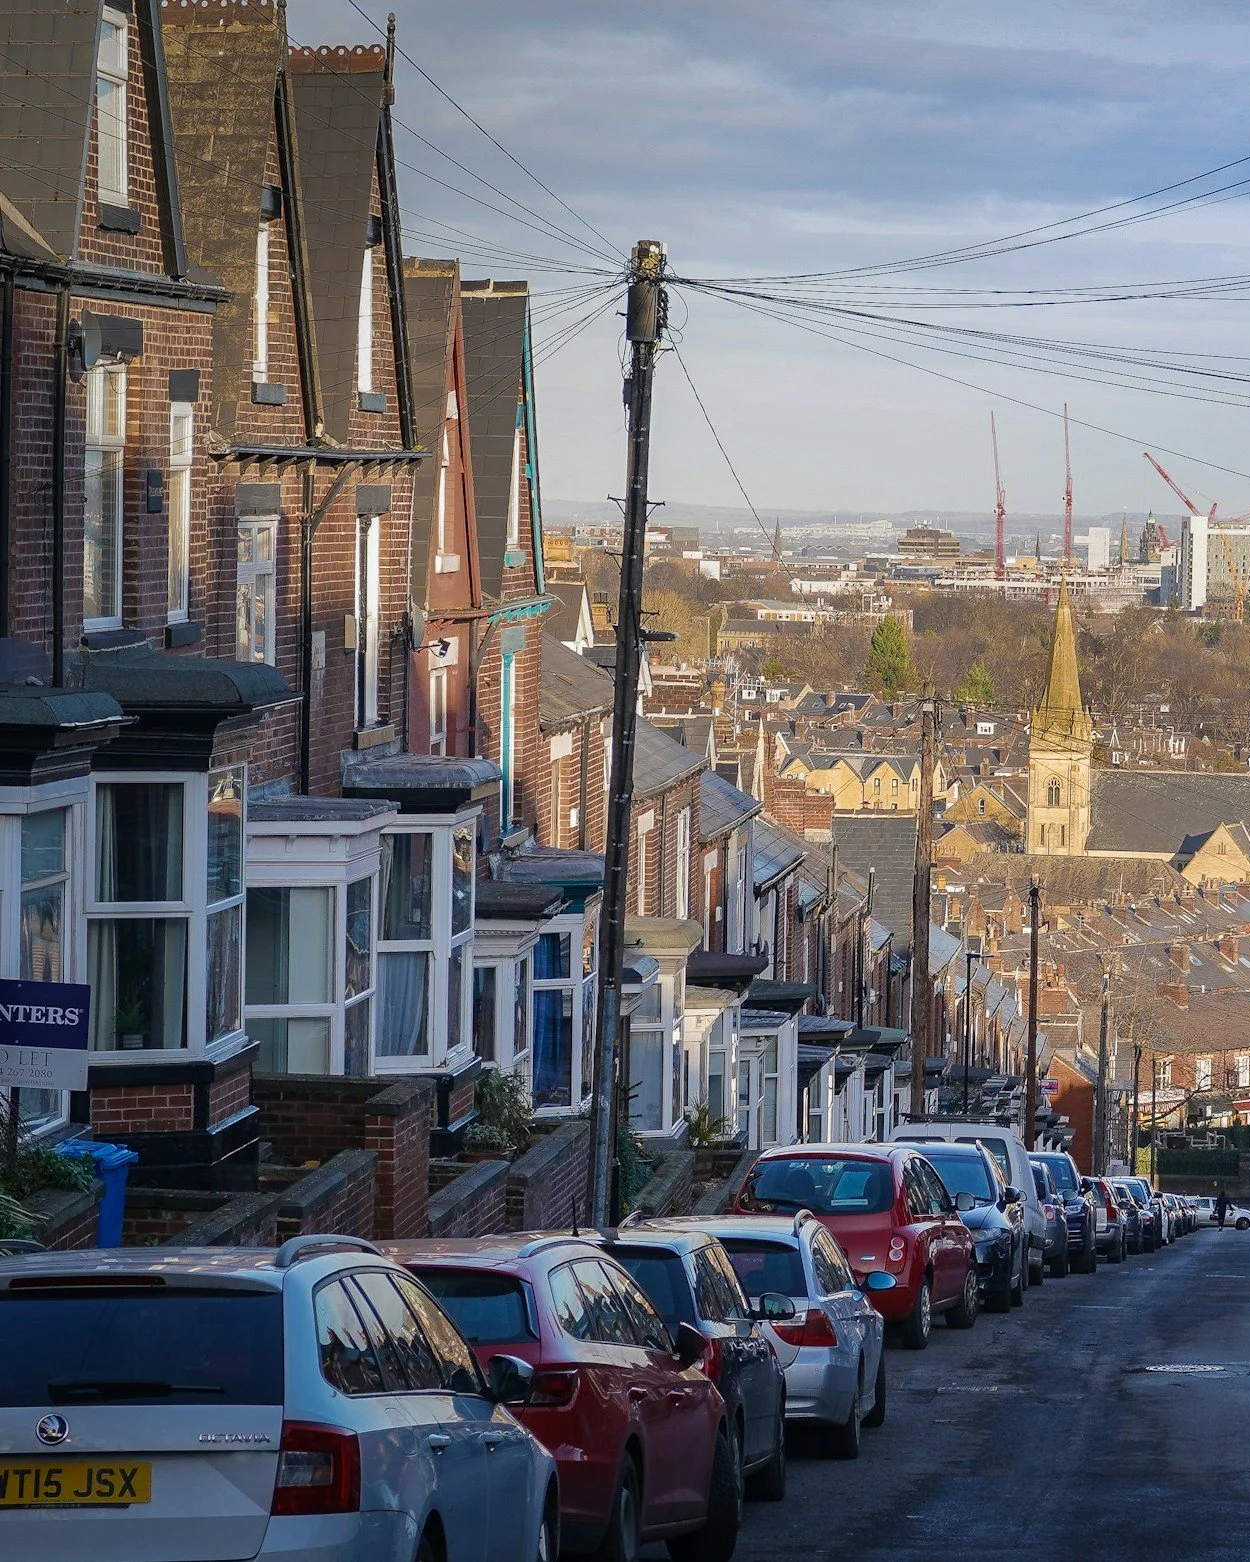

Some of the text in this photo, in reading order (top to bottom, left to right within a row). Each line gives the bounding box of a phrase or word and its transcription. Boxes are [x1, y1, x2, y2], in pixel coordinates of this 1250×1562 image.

[0, 1003, 80, 1026] NTERS
[19, 1051, 52, 1066] LET
[7, 1067, 25, 1077] 267
[28, 1069, 53, 1078] 2080
[198, 1433, 271, 1443] OCTAVIA
[73, 1468, 138, 1498] JSX
